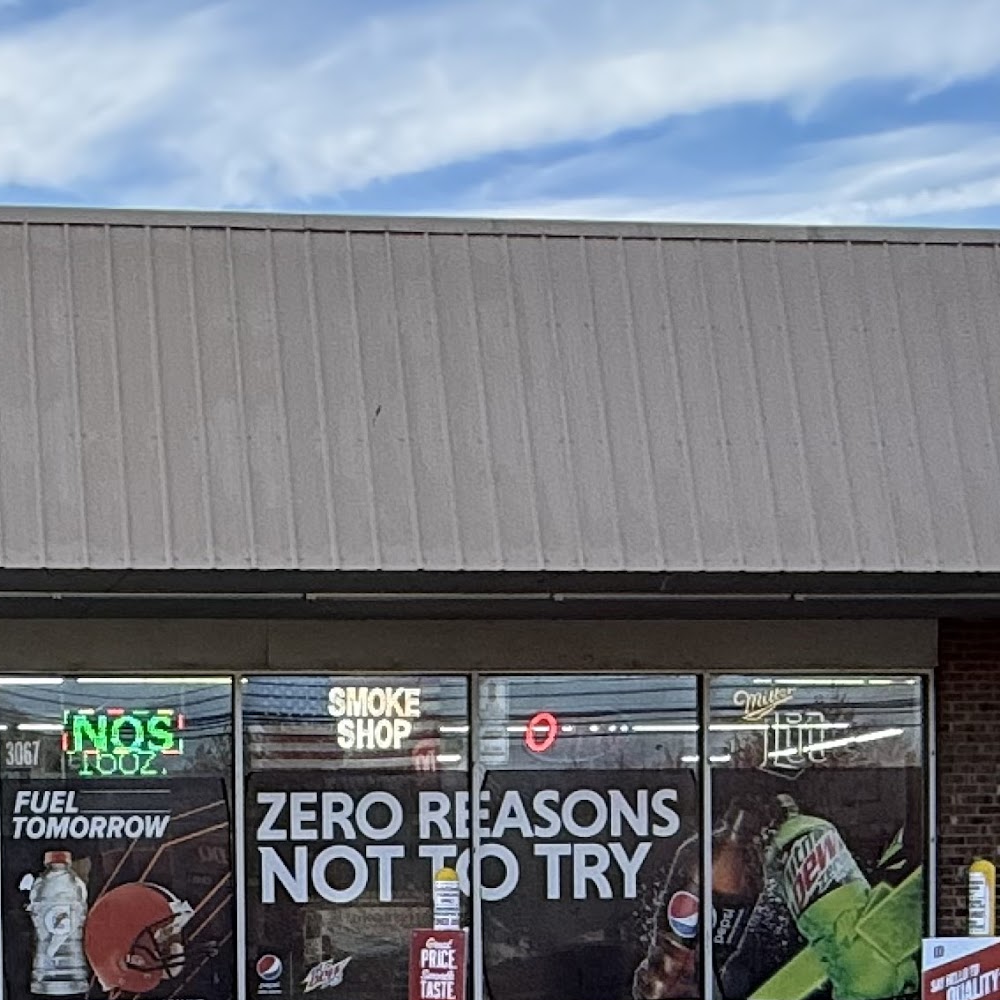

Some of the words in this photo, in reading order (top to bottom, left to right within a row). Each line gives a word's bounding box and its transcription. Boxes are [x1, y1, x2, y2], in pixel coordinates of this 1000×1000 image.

[328, 686, 422, 718] SMOKE
[72, 714, 175, 751] NOS
[337, 718, 412, 749] SHOP
[5, 740, 40, 766] 3067
[13, 790, 79, 814] FUEL
[257, 790, 404, 841] ZERO
[418, 789, 681, 839] REASONS
[12, 815, 171, 840] TOMORROW
[258, 844, 406, 904] NOT
[418, 842, 520, 904] TO
[533, 841, 653, 900] TRY
